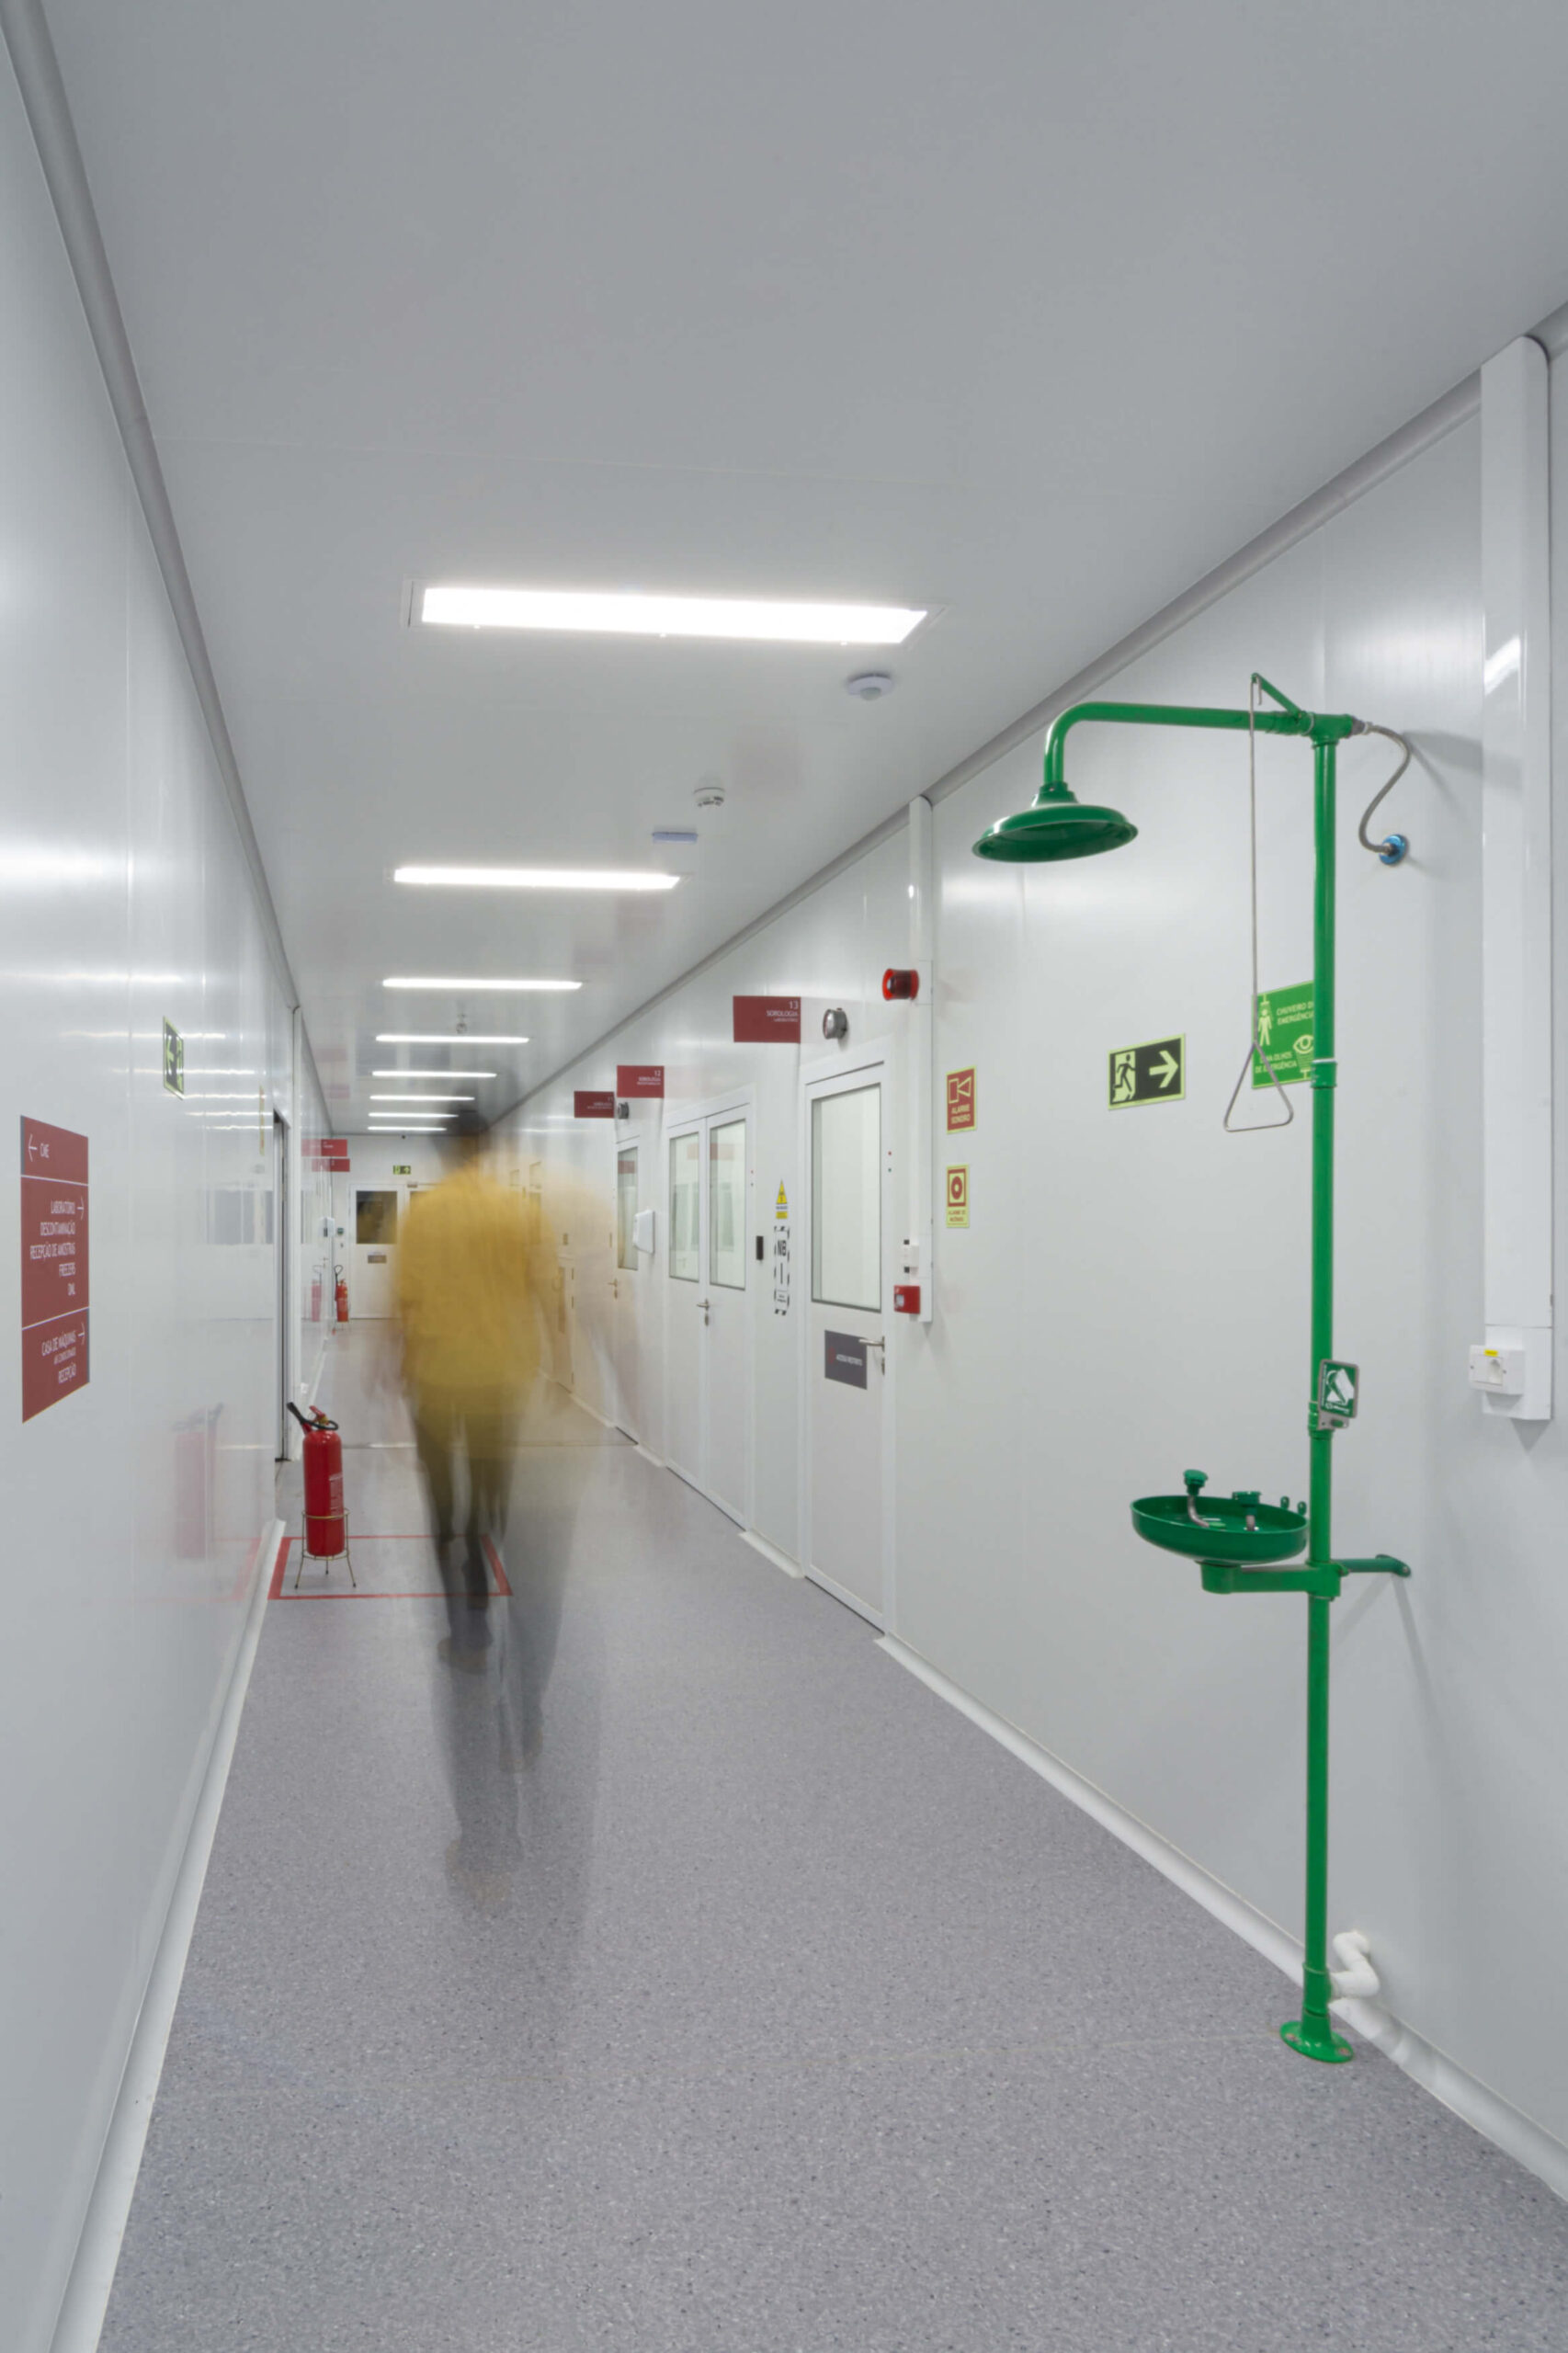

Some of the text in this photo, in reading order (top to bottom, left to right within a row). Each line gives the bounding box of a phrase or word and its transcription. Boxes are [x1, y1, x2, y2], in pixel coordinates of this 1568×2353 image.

[789, 1000, 798, 1009] 13
[1276, 1002, 1307, 1016] CHUVEIRO
[951, 1104, 971, 1114] ALARME
[950, 1114, 971, 1125] SONORO
[777, 1240, 787, 1256] NB
[41, 1340, 51, 1356] CASA
[58, 1361, 76, 1384] RECEPÇÃO
